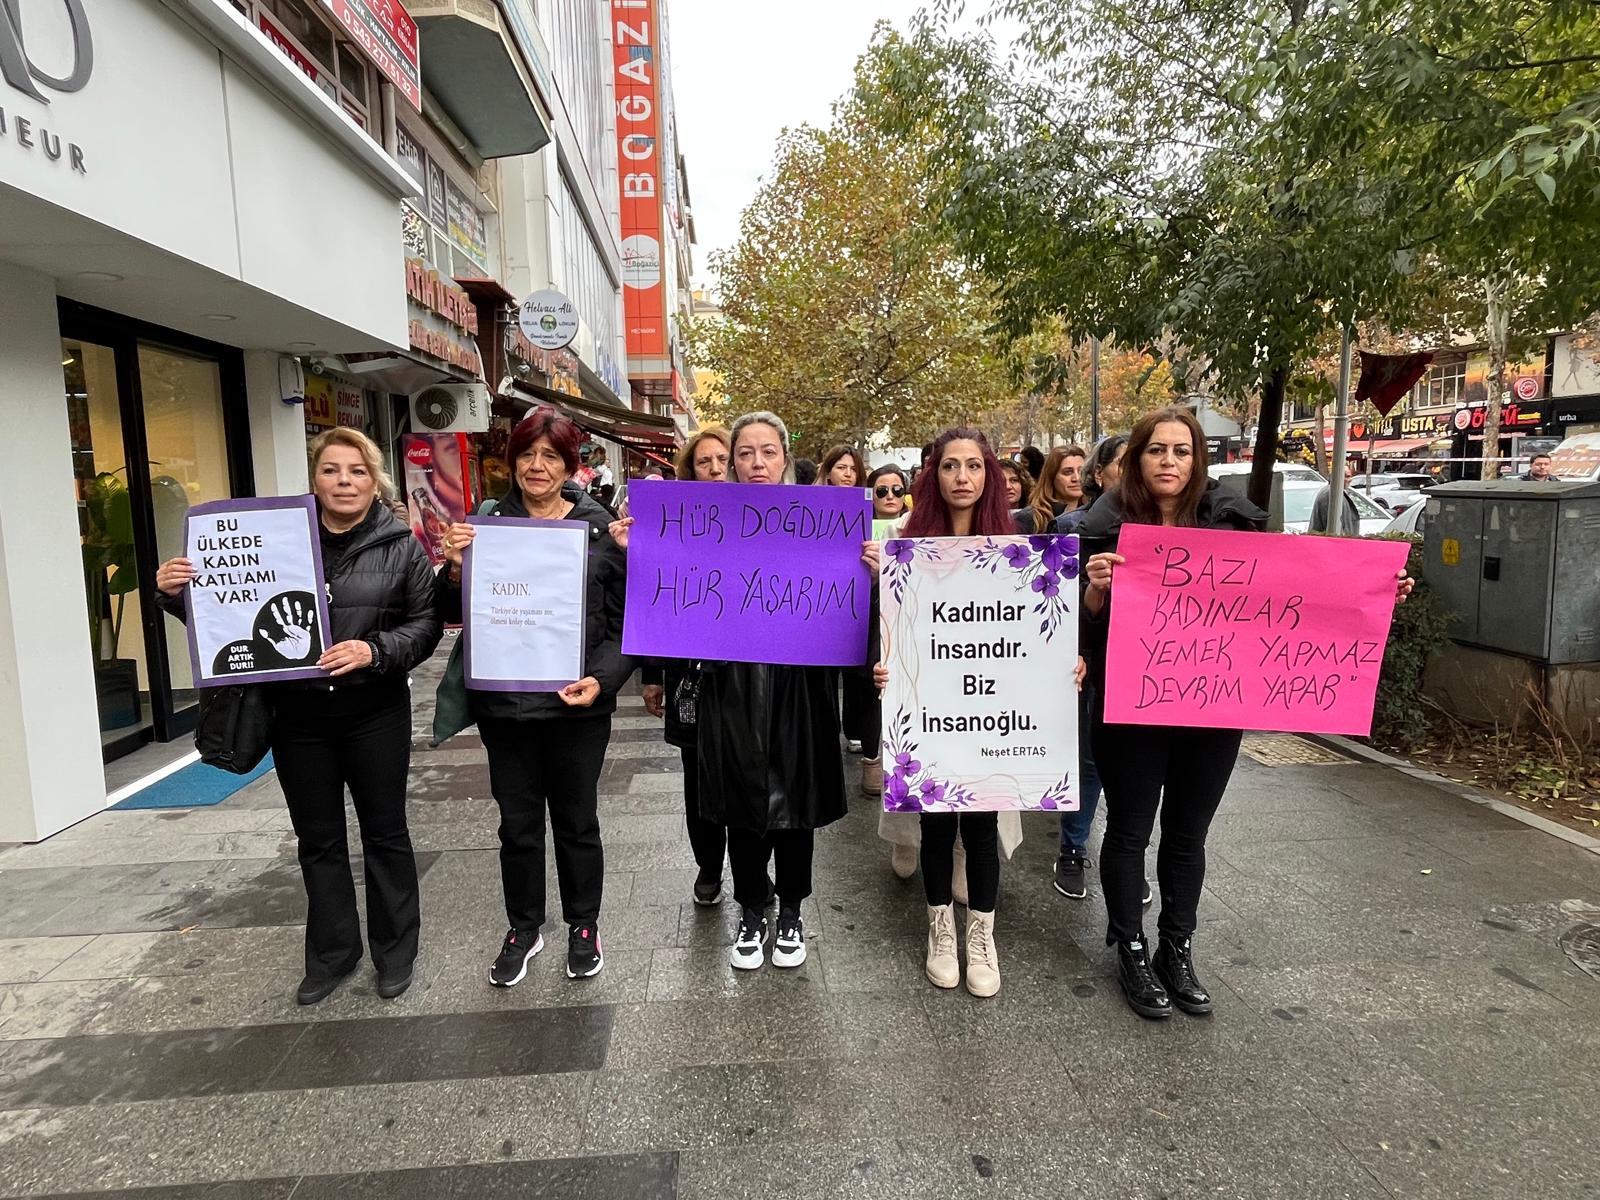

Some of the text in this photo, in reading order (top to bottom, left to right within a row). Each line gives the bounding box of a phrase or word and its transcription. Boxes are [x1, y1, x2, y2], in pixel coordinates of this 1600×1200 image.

[343, 8, 412, 97] 0 543 277 51 32
[216, 519, 238, 532] BU
[659, 500, 867, 544] HÜR DOĞDUM
[197, 535, 263, 552] ÜLKEDE
[203, 553, 260, 569] KADIN
[192, 570, 276, 588] KATLİAMI
[491, 582, 532, 596] KADIN.
[214, 589, 259, 604] VAR!
[651, 566, 858, 621] HÜR YAŞARIM
[932, 600, 1026, 623] Kadınlar
[1150, 590, 1304, 635] KADINLAR
[227, 653, 254, 662] ARTIK
[230, 645, 249, 653] DUR
[931, 633, 1028, 660] İnsandır.
[1139, 631, 1380, 672] YEMEK YAPMAZ
[963, 674, 996, 696] Biz
[1134, 674, 1243, 710] DEVRİM
[922, 706, 1037, 737] İnsanoğlu.
[981, 746, 1047, 758] Neşet ERTAŞ
